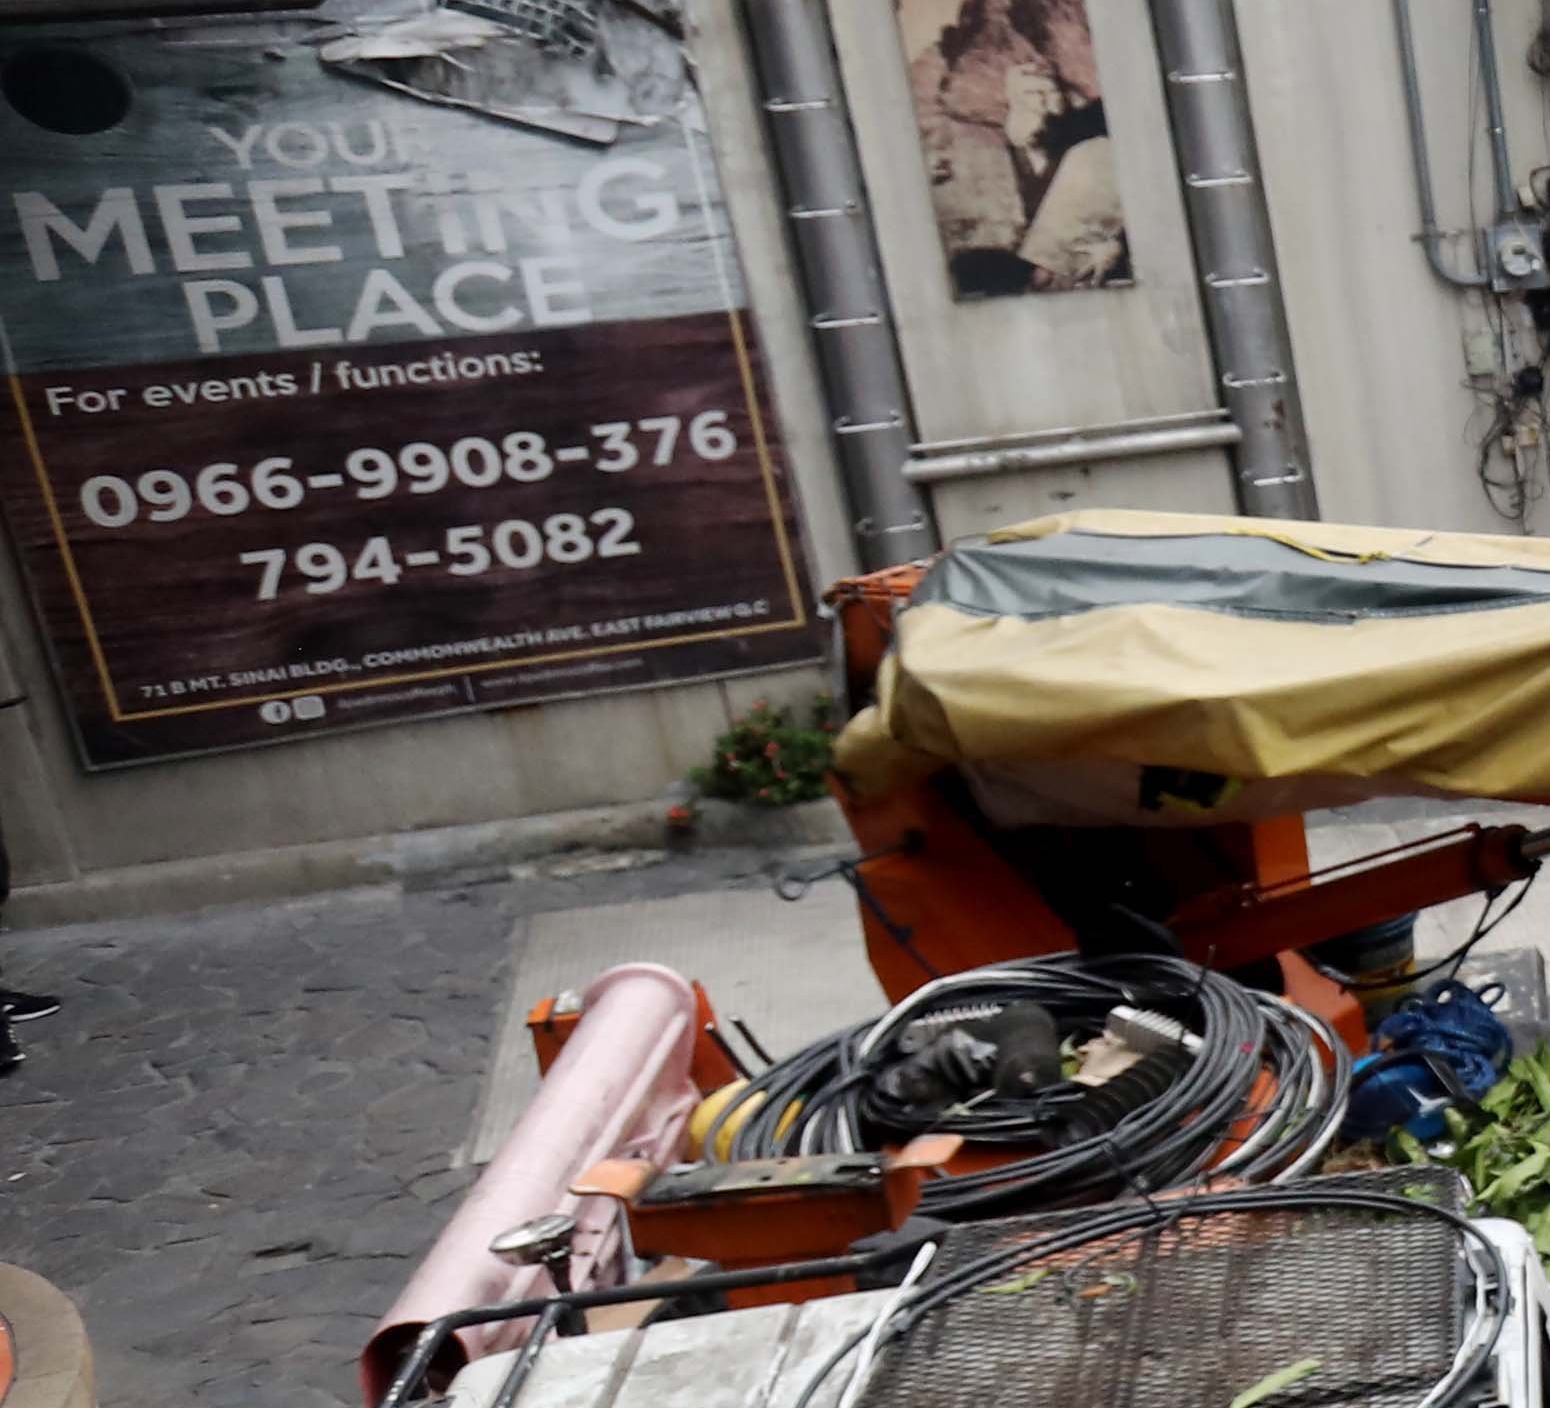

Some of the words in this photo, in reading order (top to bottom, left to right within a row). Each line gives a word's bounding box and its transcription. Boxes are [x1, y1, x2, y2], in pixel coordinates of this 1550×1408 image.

[211, 117, 427, 170] YOUR
[14, 157, 682, 281] MEETING
[183, 261, 593, 355] PLACE
[46, 384, 127, 417] For
[144, 369, 297, 407] events
[336, 348, 544, 392] functions:
[79, 409, 738, 528] 0966-9908-376
[240, 507, 641, 601] 794-5082
[363, 629, 545, 669] COMMONWEALTH
